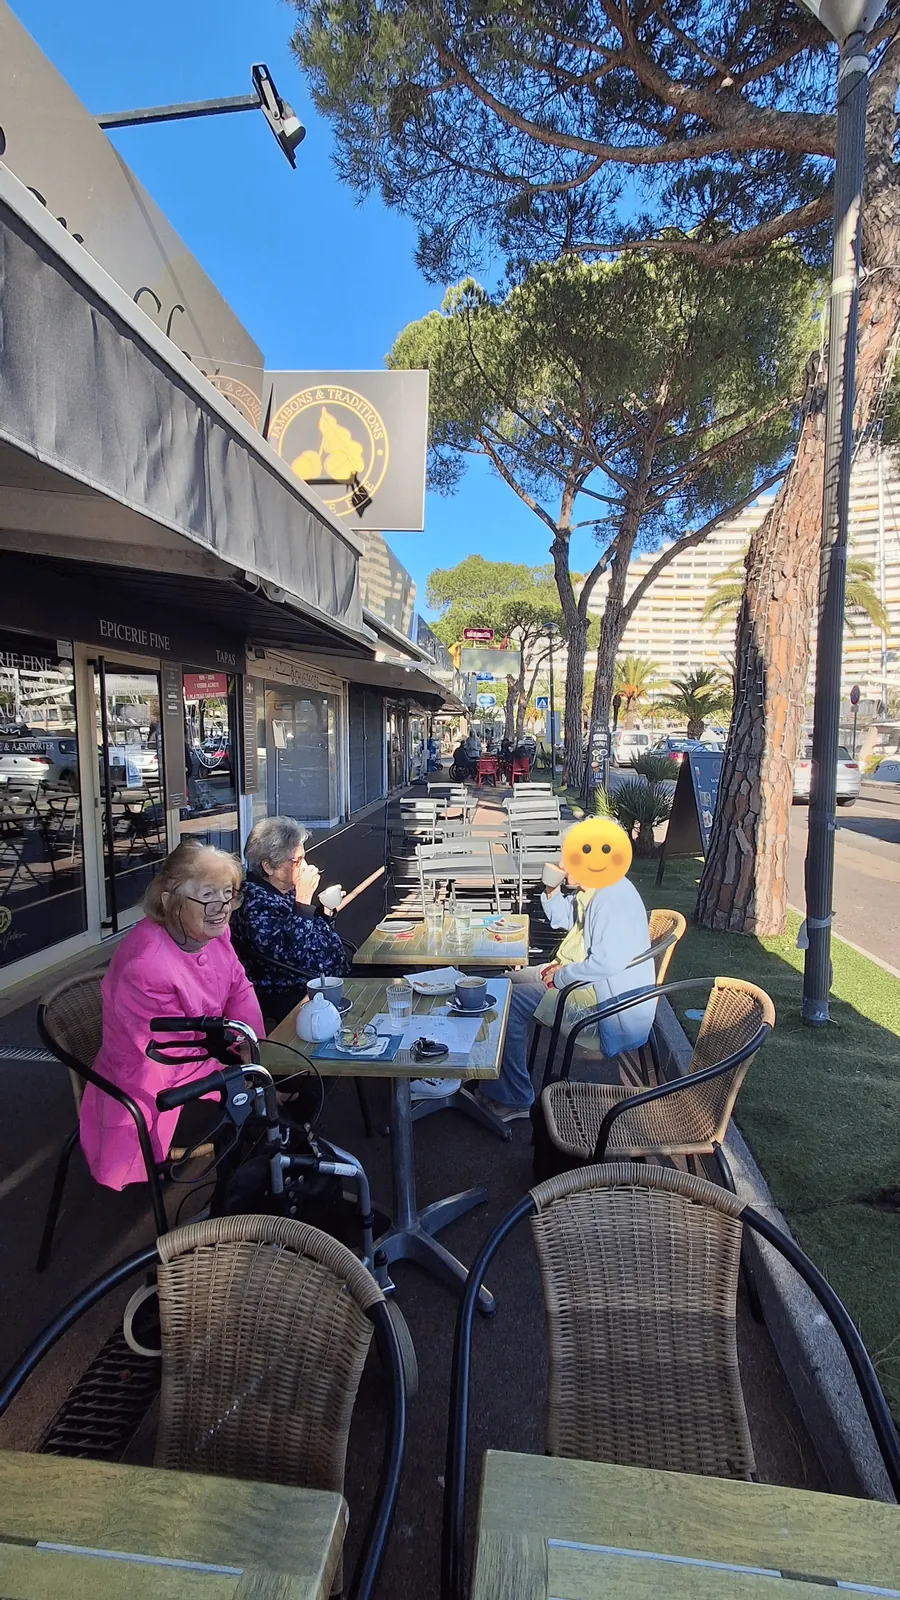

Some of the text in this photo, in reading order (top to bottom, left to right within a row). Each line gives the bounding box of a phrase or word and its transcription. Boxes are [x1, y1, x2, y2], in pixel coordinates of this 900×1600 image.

[271, 388, 384, 440] JAMBONS & TRADITIONS
[345, 480, 375, 508] FINE
[99, 619, 171, 650] EPICERIE FINE
[22, 654, 52, 672] FINE
[216, 650, 236, 665] TAPAS
